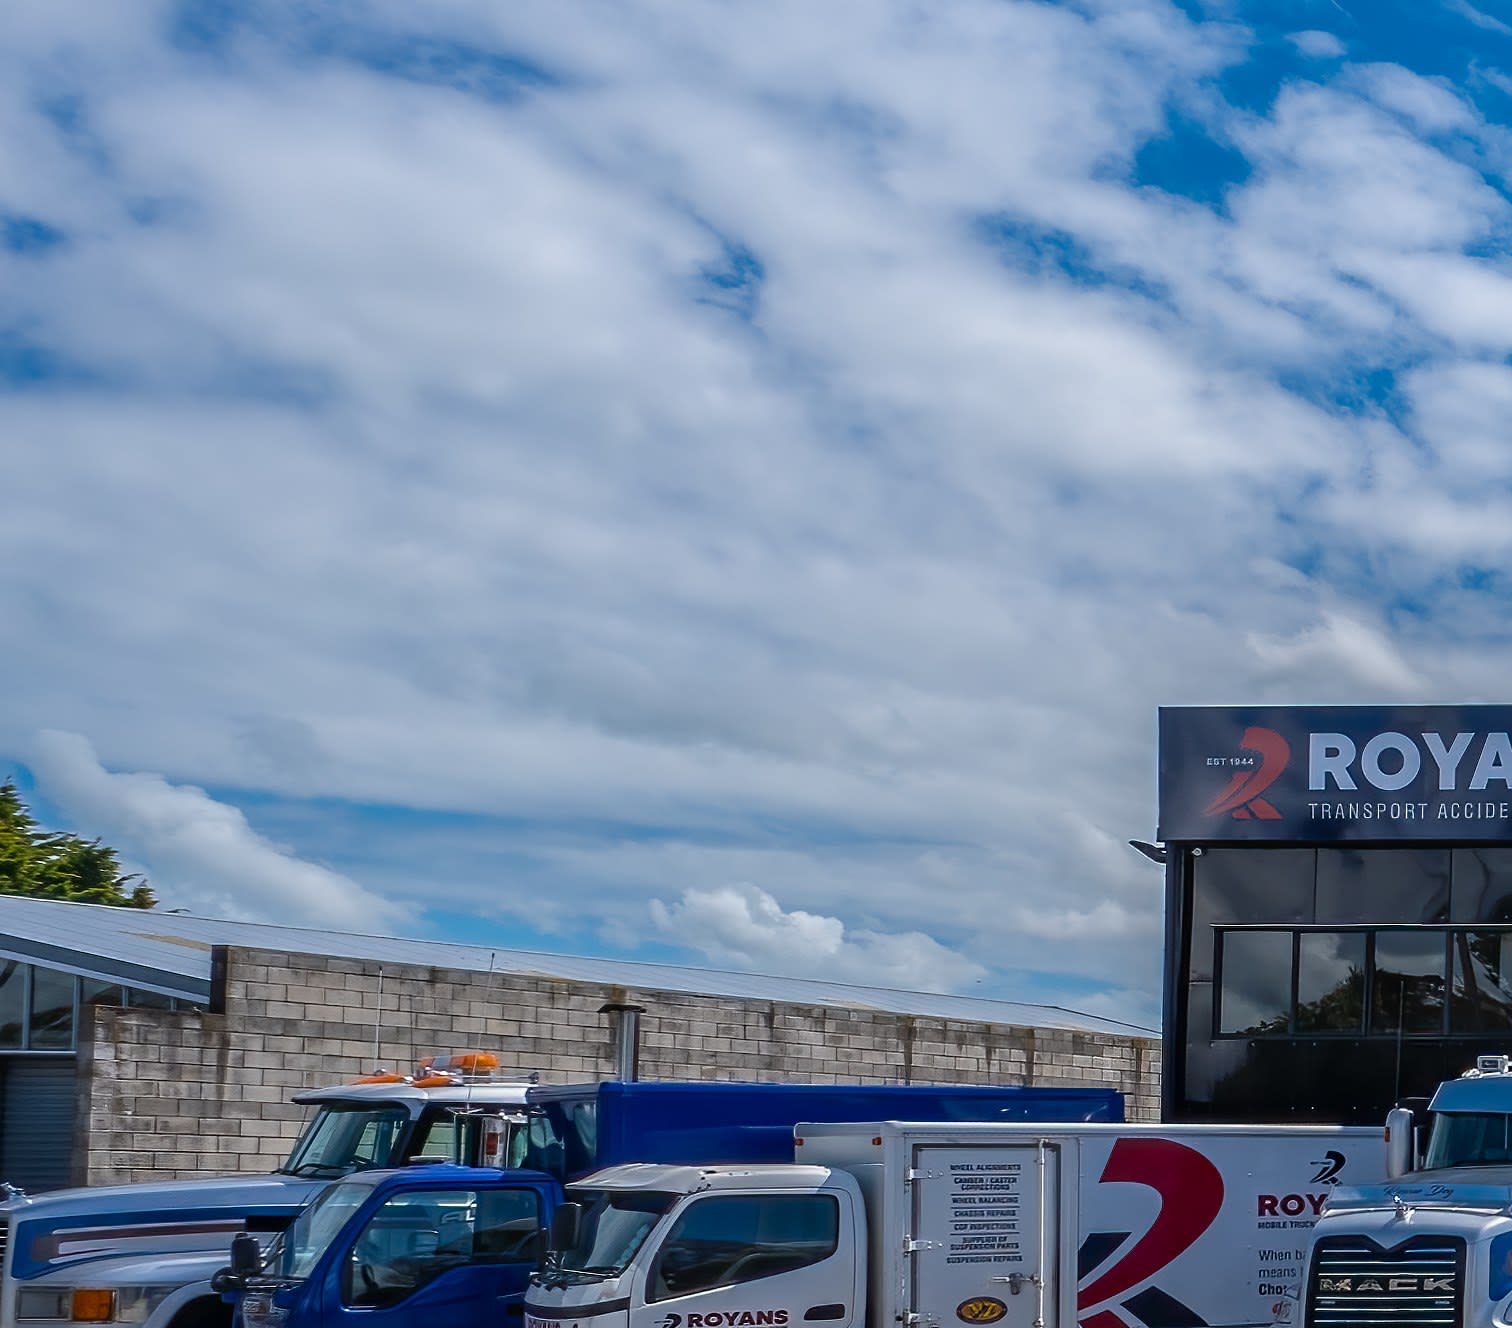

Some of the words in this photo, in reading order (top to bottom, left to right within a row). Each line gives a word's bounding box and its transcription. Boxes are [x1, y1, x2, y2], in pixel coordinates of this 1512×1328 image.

[1206, 757, 1227, 766] EST
[1230, 757, 1254, 766] 1944
[1308, 802, 1428, 819] TRANSPORT
[1258, 1194, 1328, 1217] ROY
[1258, 1221, 1287, 1229] MOBILE
[1259, 1250, 1291, 1261] When
[1259, 1267, 1296, 1278] means
[1320, 1278, 1456, 1291] MACK
[687, 1310, 789, 1328] ROYANS
